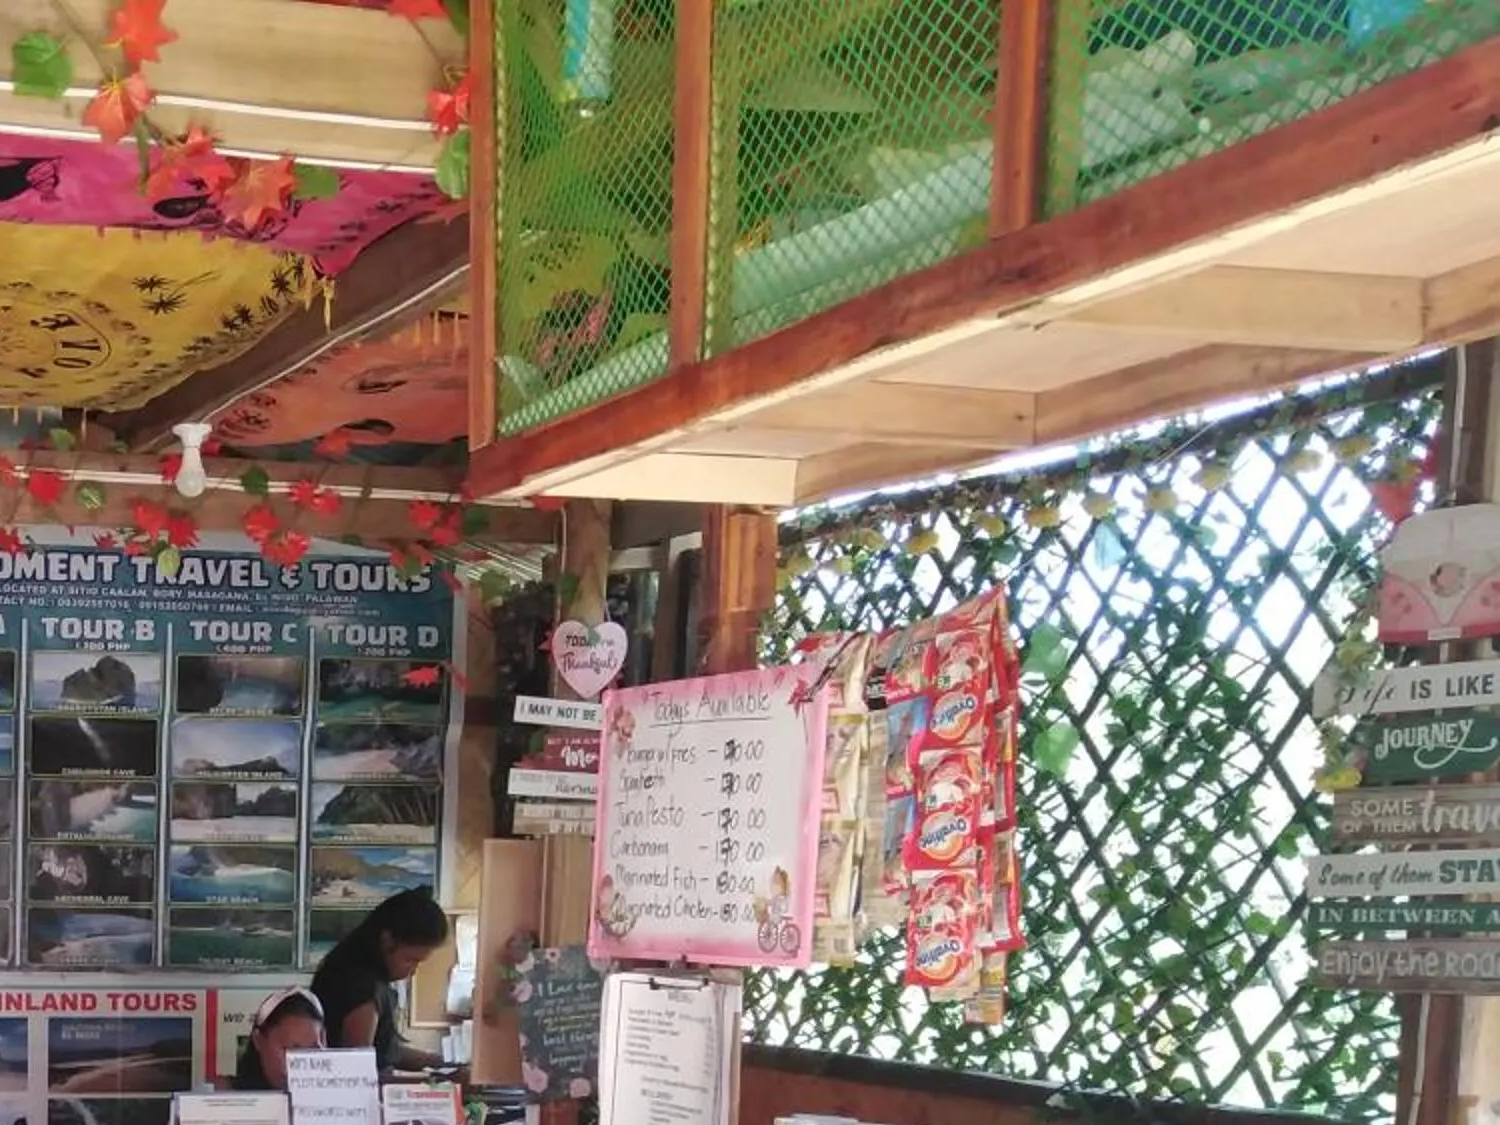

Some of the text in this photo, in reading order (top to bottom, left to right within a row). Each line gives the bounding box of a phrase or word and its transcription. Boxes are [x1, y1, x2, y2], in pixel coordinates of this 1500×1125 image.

[50, 585, 65, 596] AT
[41, 616, 156, 642] TOUR B
[189, 619, 298, 643] TOUR C
[327, 624, 440, 649] TOUR D
[565, 634, 594, 648] TOD
[1410, 679, 1432, 700] IS
[1445, 673, 1495, 698] LIKE
[528, 705, 552, 717] MAY
[556, 708, 578, 721] NOT
[582, 710, 597, 722] BE
[1374, 717, 1496, 764] JOURNEY
[555, 779, 599, 794] norma
[1350, 789, 1500, 835] SOME trav
[918, 816, 968, 850] Ovaltine
[1342, 818, 1418, 834] OF THEM
[1317, 863, 1366, 887] Some
[1368, 864, 1388, 891] of
[1390, 862, 1434, 884] them
[1318, 907, 1344, 923] IN
[1351, 907, 1477, 925] BETWEEN
[915, 939, 962, 967] Ovaltine
[1320, 950, 1390, 985] Enjoy
[1392, 949, 1441, 978] the
[106, 992, 198, 1013] TOURS
